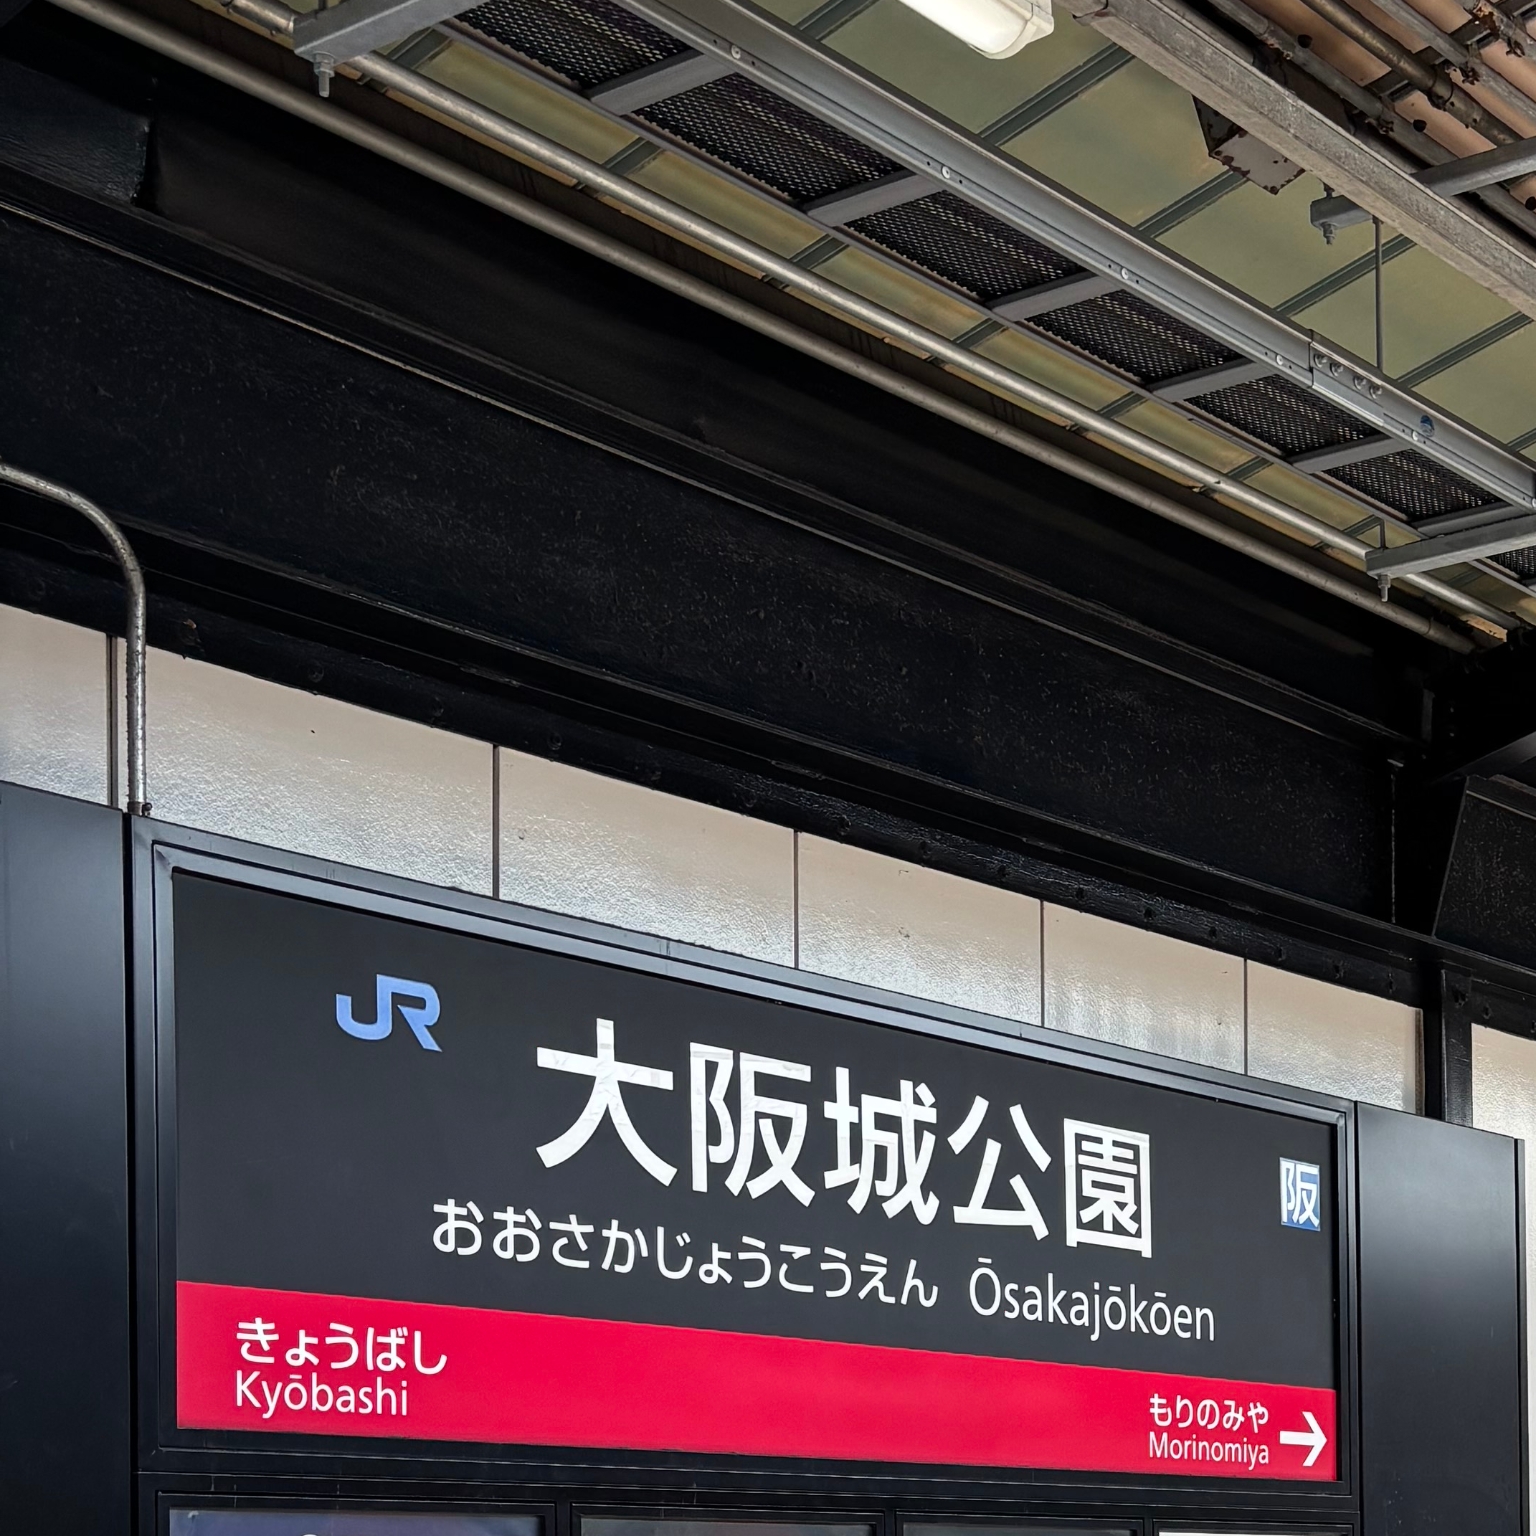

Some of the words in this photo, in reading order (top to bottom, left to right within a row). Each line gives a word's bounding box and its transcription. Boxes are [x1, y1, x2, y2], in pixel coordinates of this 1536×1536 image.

[336, 974, 442, 1052] JR
[536, 1017, 1153, 1258] 大阪城公園
[1282, 1162, 1320, 1227] 阪
[433, 1198, 939, 1308] おおさかじょうこうえん
[969, 1257, 1216, 1343] Ōsakajōkōen
[236, 1317, 448, 1375] きょうばし
[236, 1370, 408, 1419] Kyōbashi
[1149, 1393, 1269, 1433] もりのみや
[1149, 1431, 1269, 1471] Morinomiya
